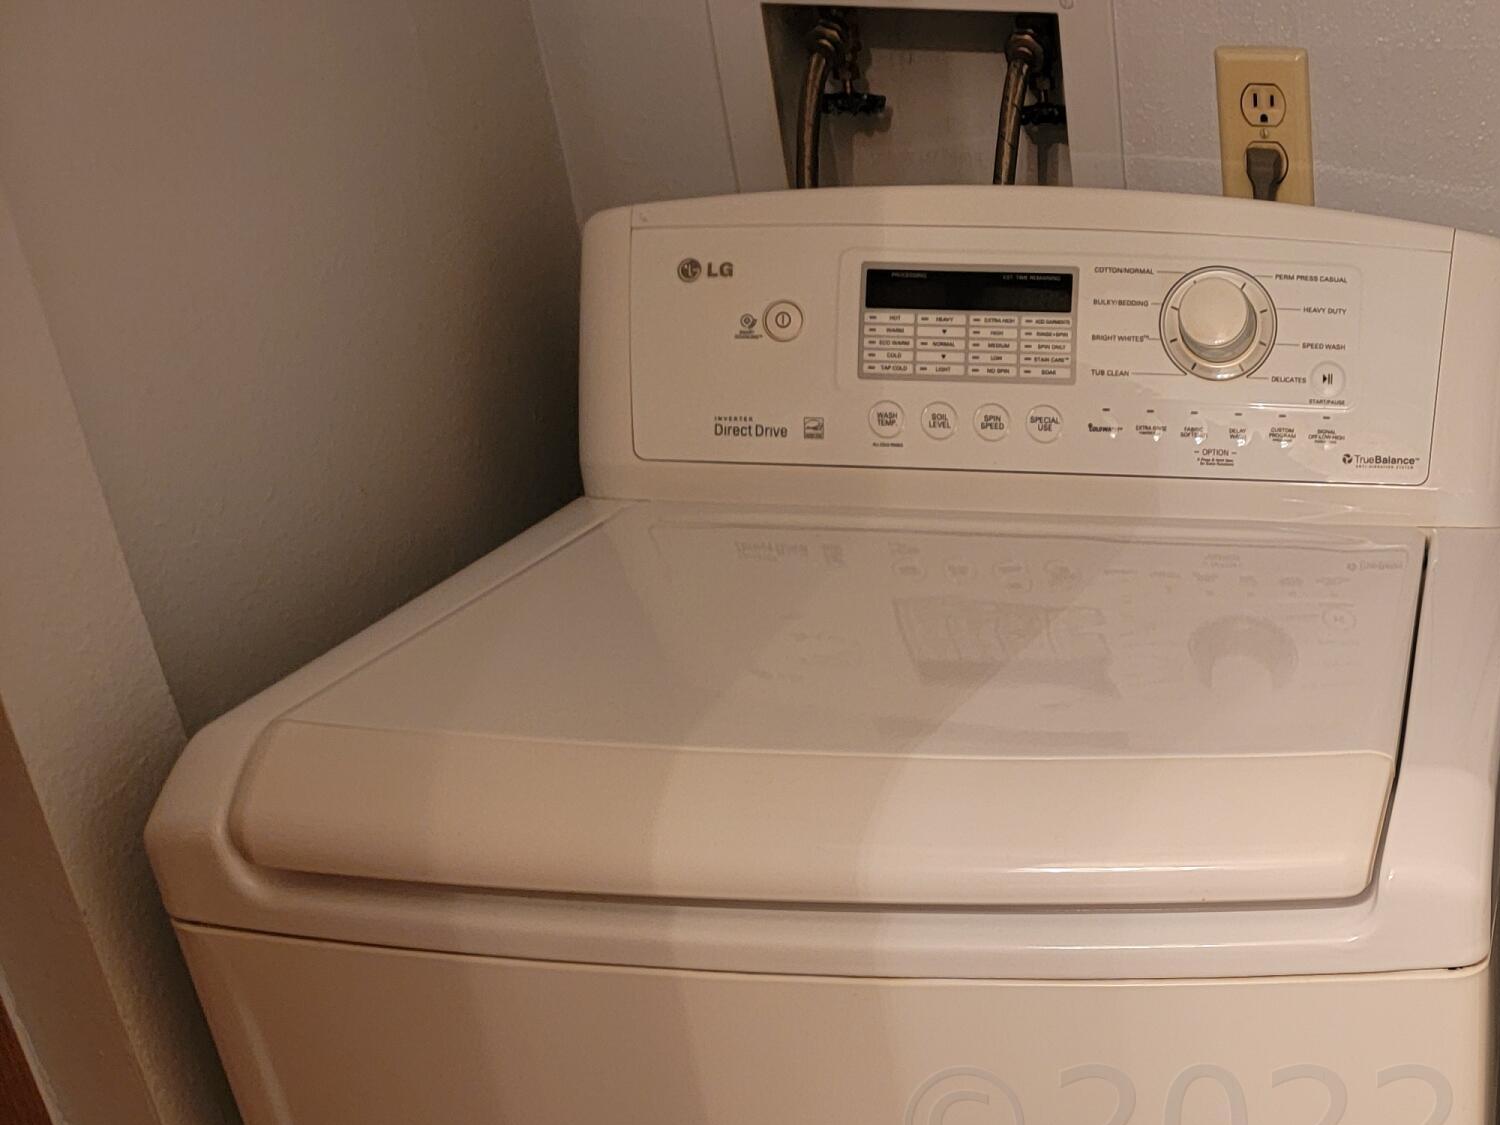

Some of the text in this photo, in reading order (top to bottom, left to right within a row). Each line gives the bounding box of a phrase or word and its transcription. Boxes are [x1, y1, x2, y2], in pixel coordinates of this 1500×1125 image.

[707, 262, 733, 278] LG
[1319, 276, 1348, 284] CASUAL
[1302, 342, 1346, 351] SPEED WASH
[1091, 369, 1130, 377] TUB CLEAN
[1271, 376, 1307, 384] DELICATES
[931, 413, 949, 421] SOIL
[983, 415, 1001, 423] SPIN
[1030, 416, 1060, 424] SPECIAL
[929, 420, 951, 429] LEVEL
[980, 422, 1004, 430] SPEED
[1037, 423, 1052, 432] USE
[714, 423, 753, 438] Direct
[755, 424, 788, 438] Drive
